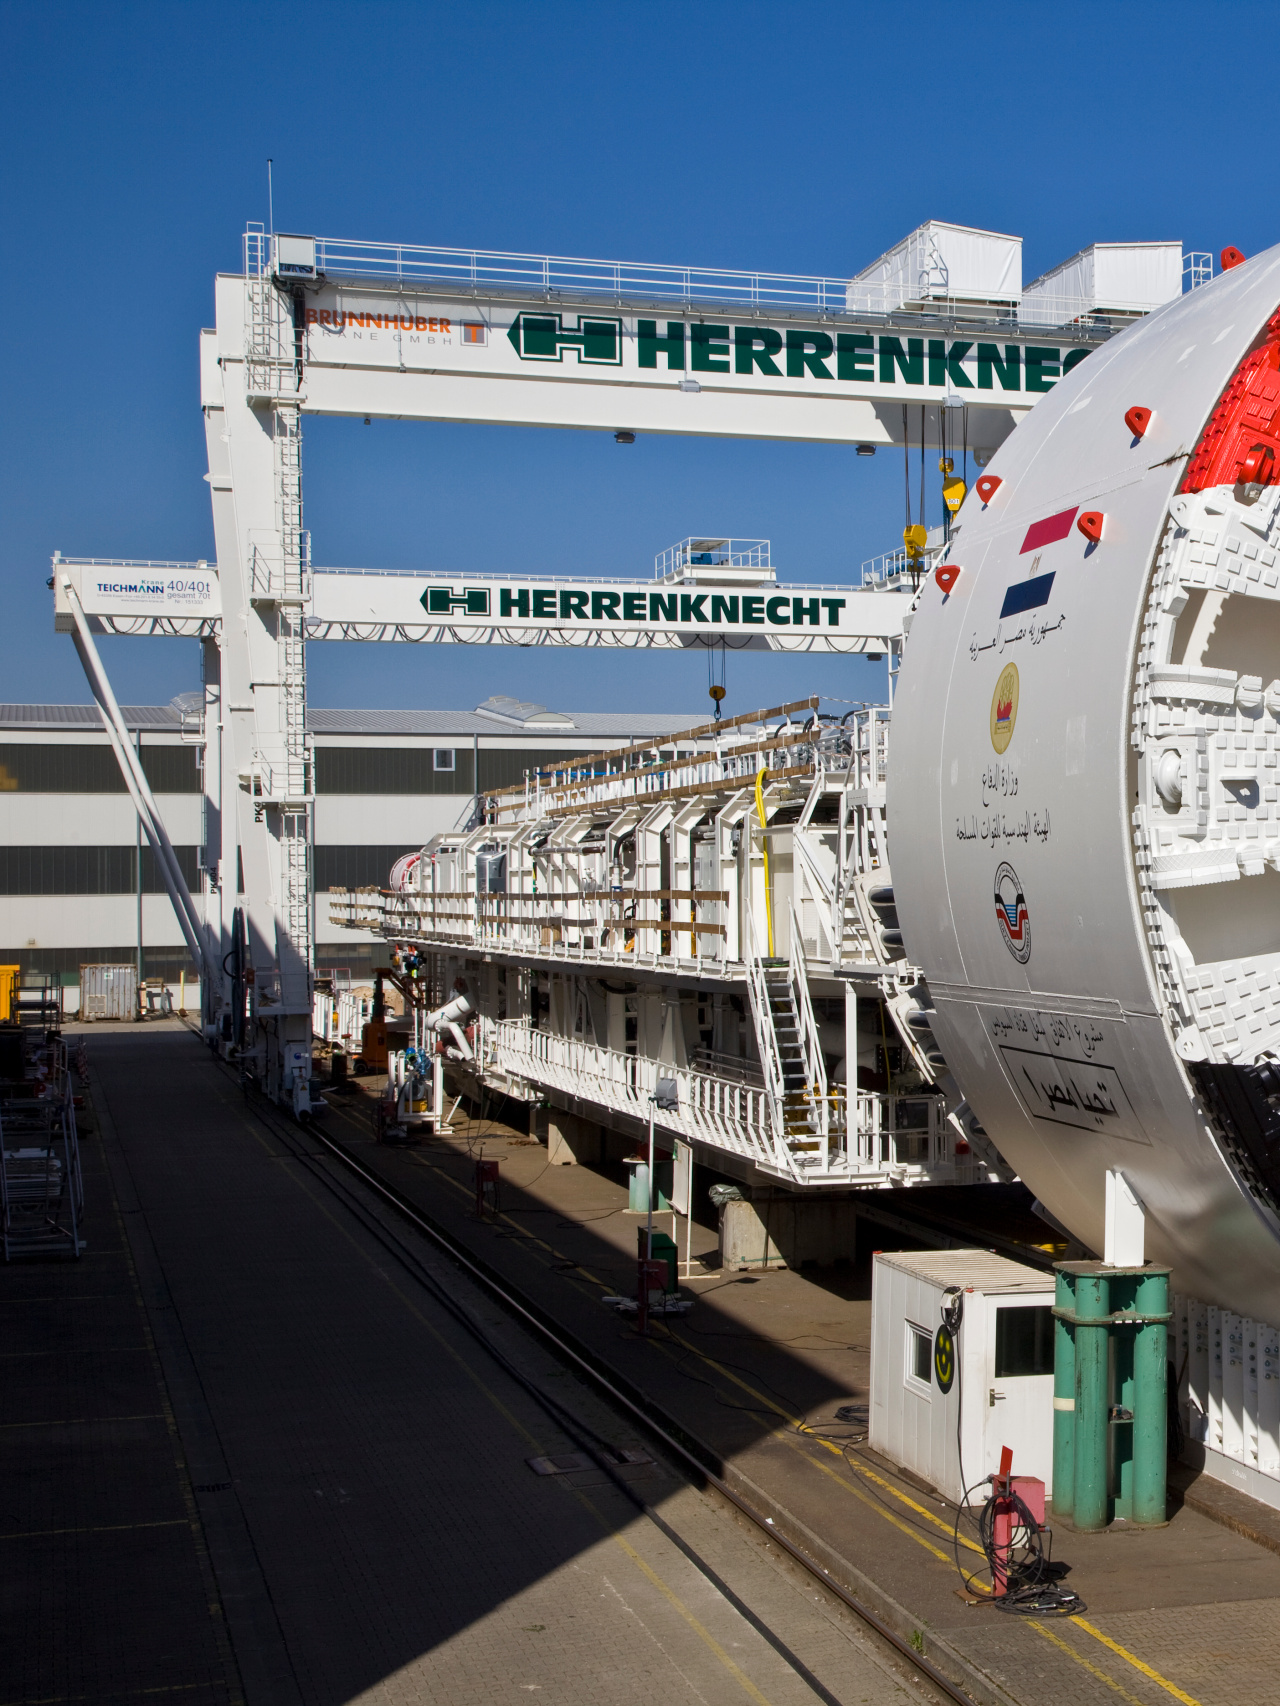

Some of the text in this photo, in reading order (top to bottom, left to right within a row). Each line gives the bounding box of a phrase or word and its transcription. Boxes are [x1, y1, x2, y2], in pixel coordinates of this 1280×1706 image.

[305, 308, 452, 333] BRUNNHUBER
[393, 334, 452, 346] GMBH
[637, 319, 1094, 393] HERRENKNE
[97, 583, 164, 594] TEICHMANN
[167, 592, 196, 600] gesamt
[500, 588, 846, 626] HERRENKNECHT
[969, 613, 1066, 661] جمهورية مصر العربية
[982, 763, 1018, 807] وزارة الدفاع
[1069, 1077, 1120, 1126] تحيا
